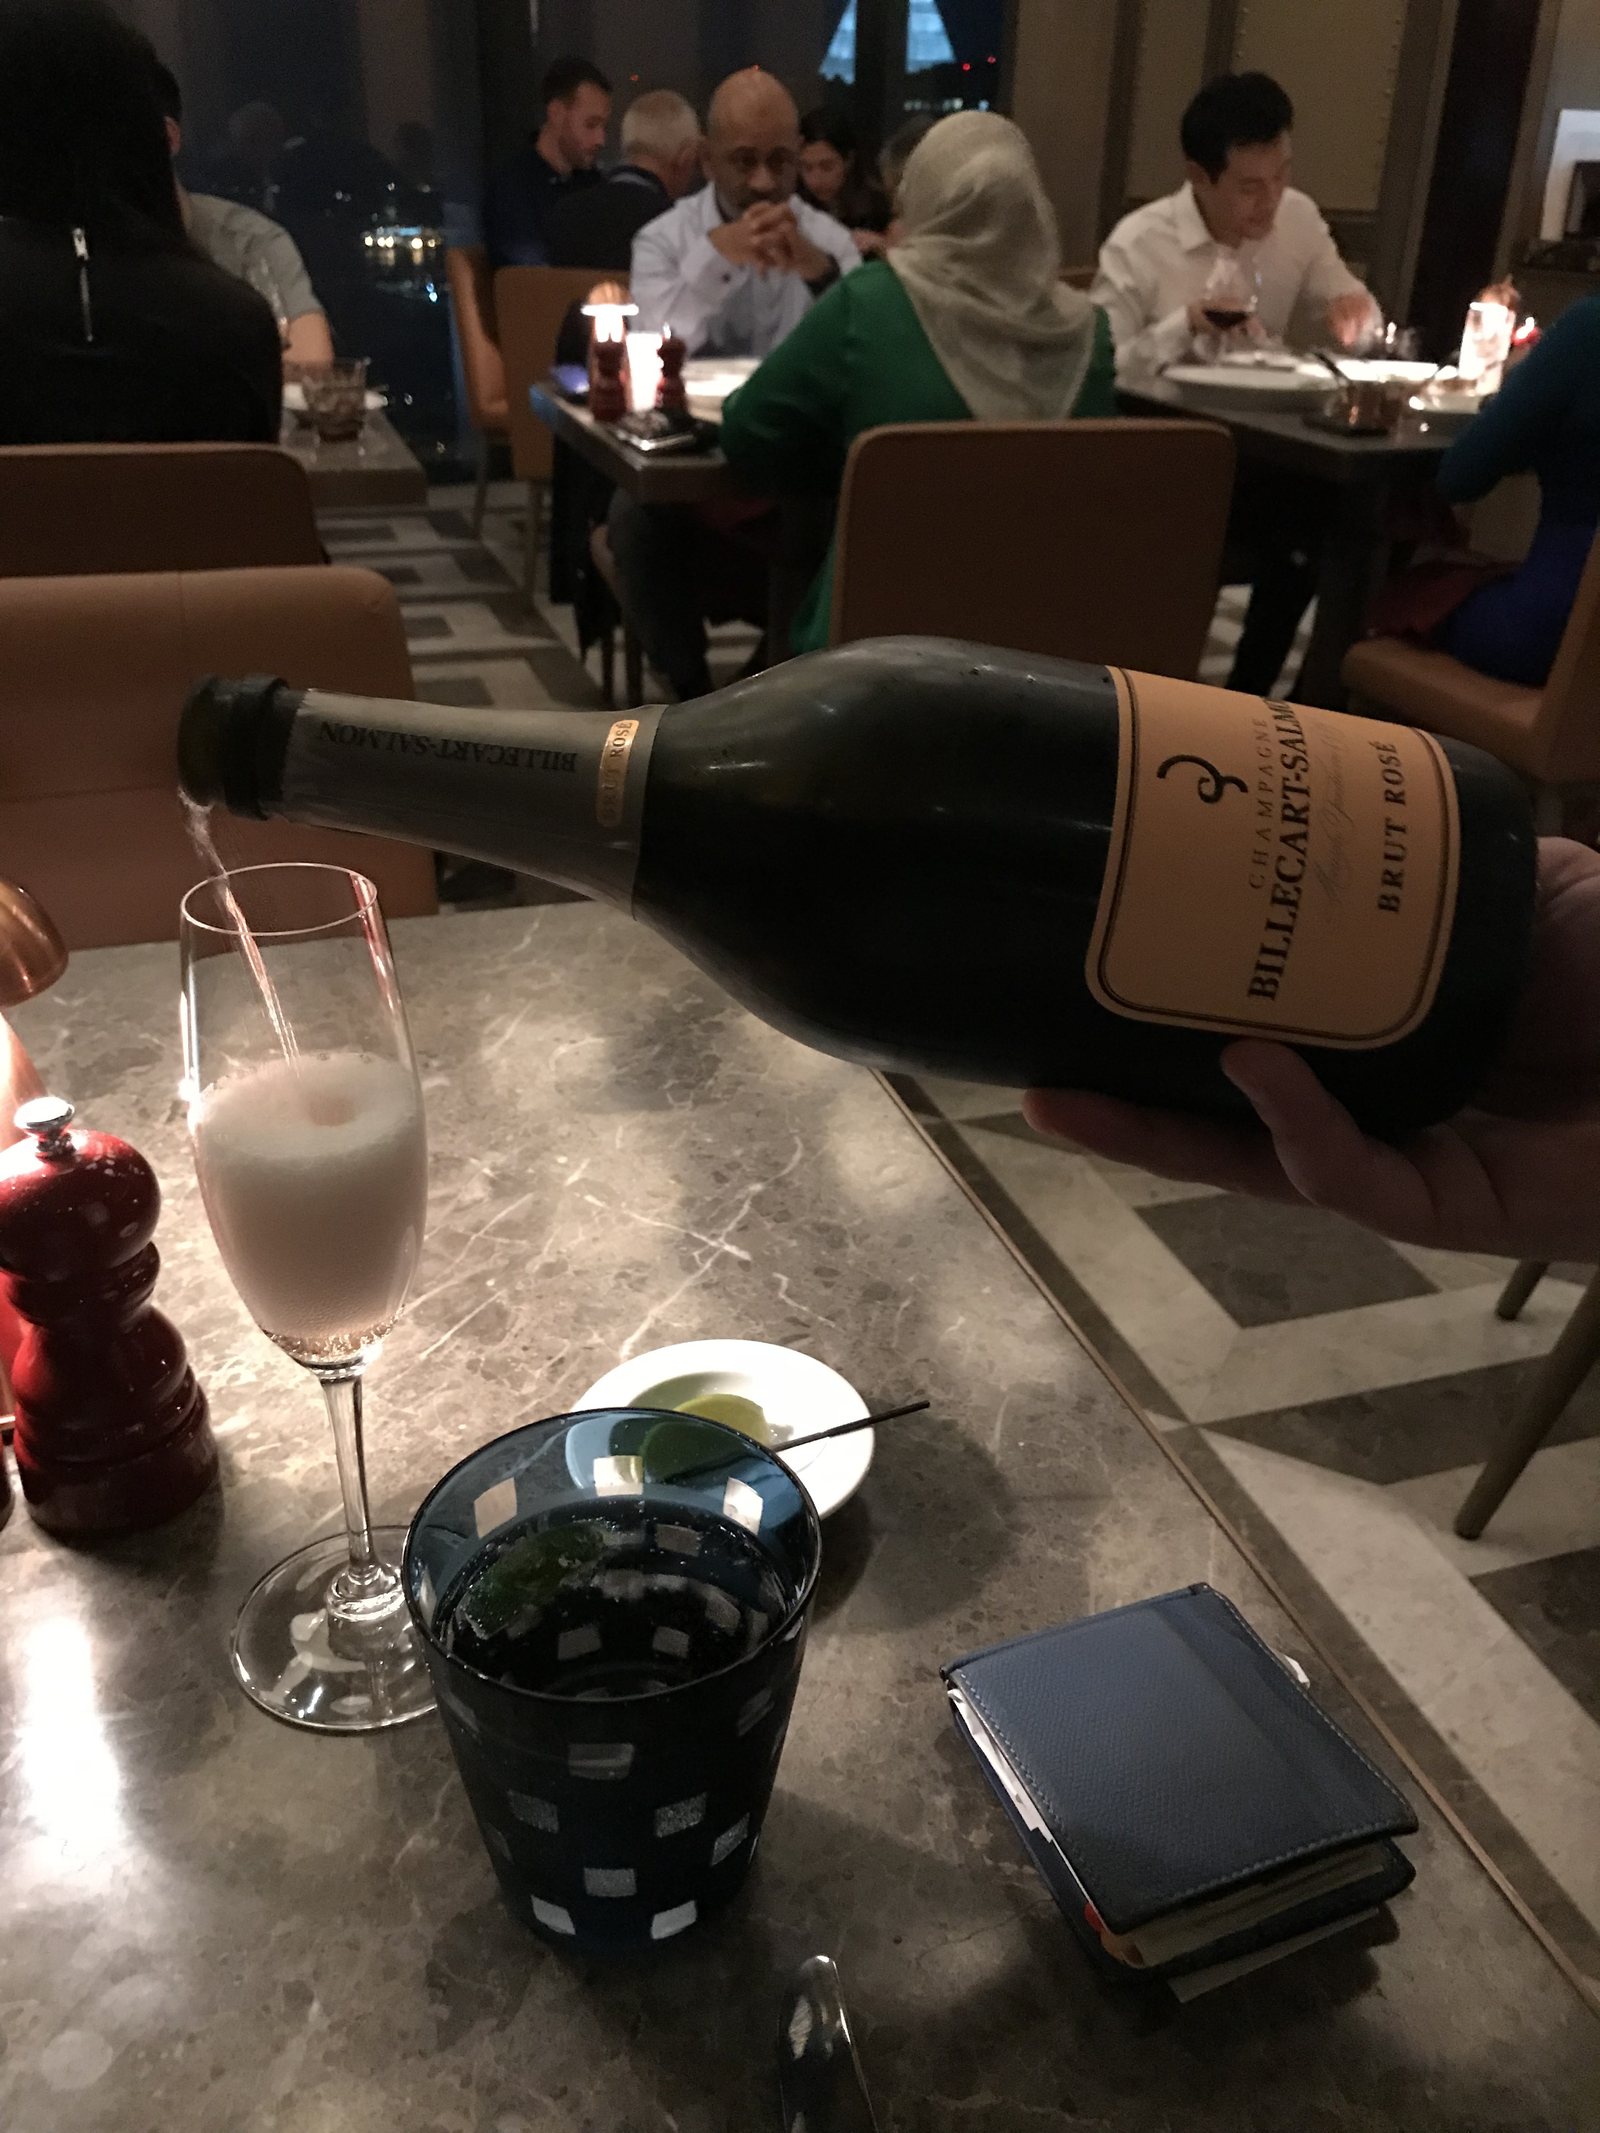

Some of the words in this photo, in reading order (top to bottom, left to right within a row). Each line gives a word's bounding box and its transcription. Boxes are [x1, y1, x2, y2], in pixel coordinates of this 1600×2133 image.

[319, 721, 578, 772] BILLECART-SALMON
[1368, 741, 1406, 806] ROSÉ
[1247, 698, 1310, 1001] BILLECART-SALMO
[1250, 718, 1275, 890] CHAMPAGNE
[1377, 818, 1408, 913] BRUT
